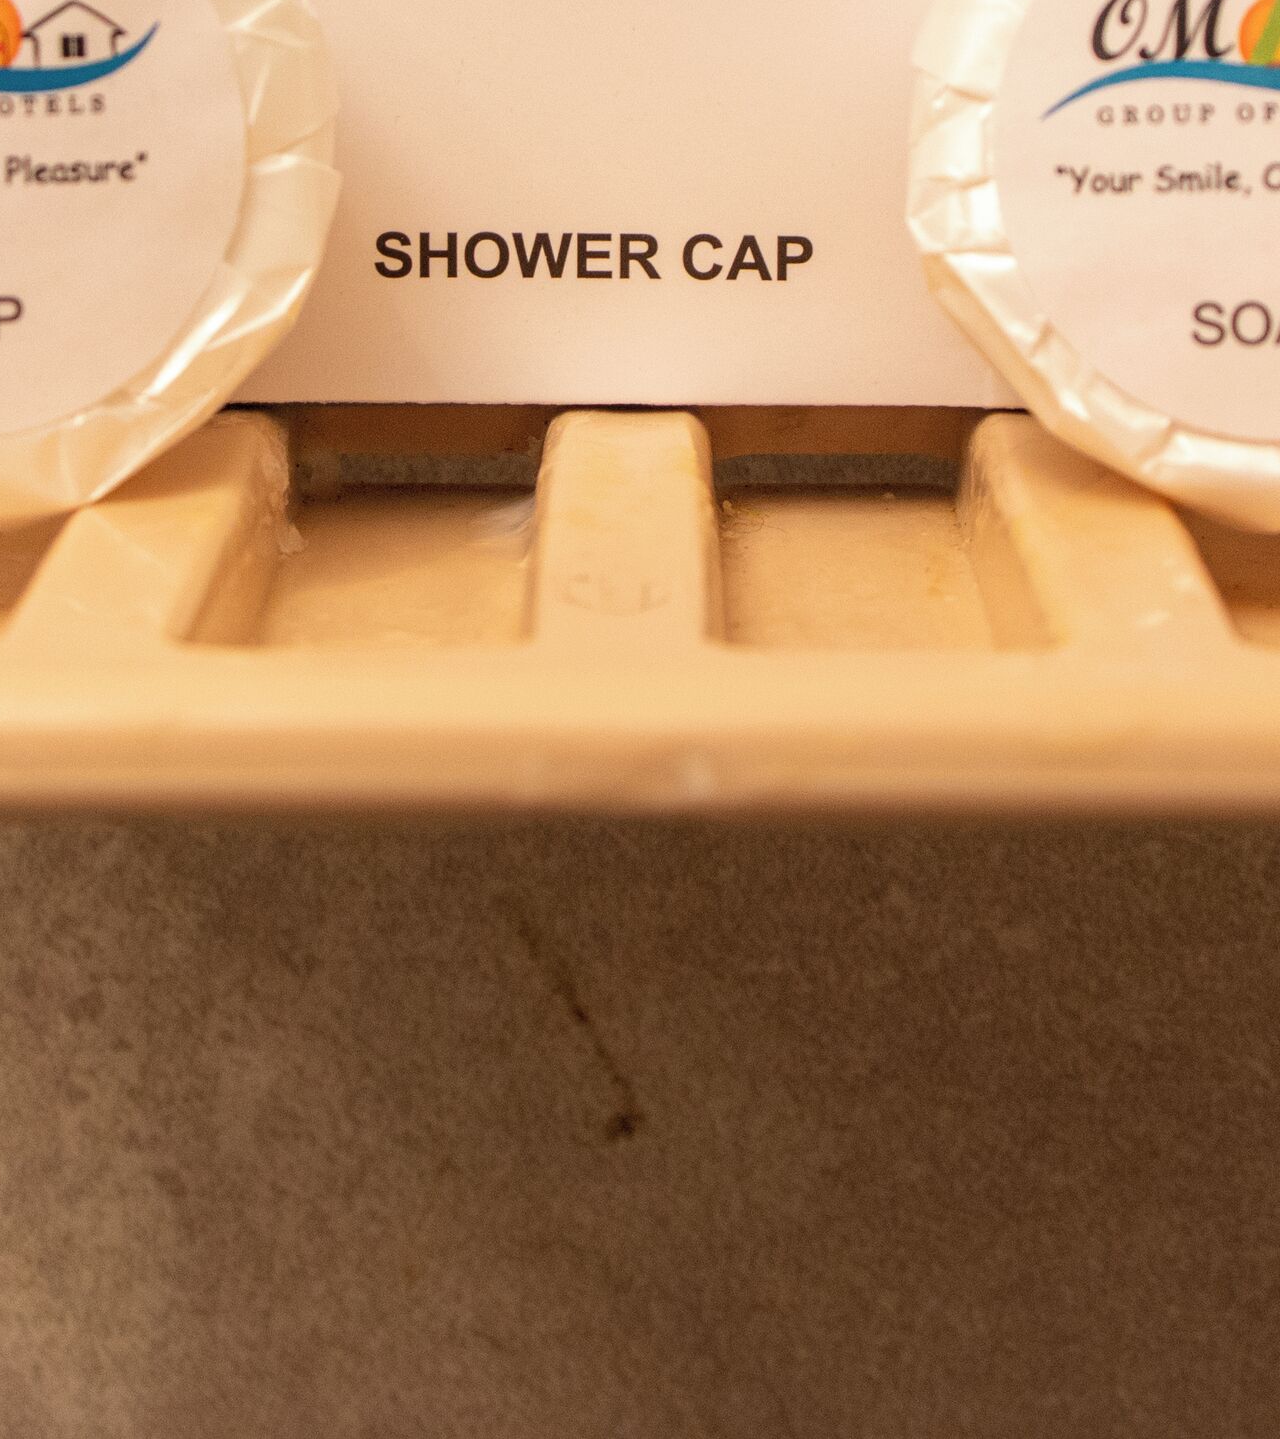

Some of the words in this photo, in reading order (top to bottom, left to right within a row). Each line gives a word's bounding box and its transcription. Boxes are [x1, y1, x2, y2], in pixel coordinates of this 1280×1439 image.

[1096, 104, 1216, 125] GROUP
[1237, 102, 1280, 123] OF
[1154, 163, 1251, 196] Smile,
[373, 230, 662, 280] SHOWER
[682, 233, 814, 282] CAP
